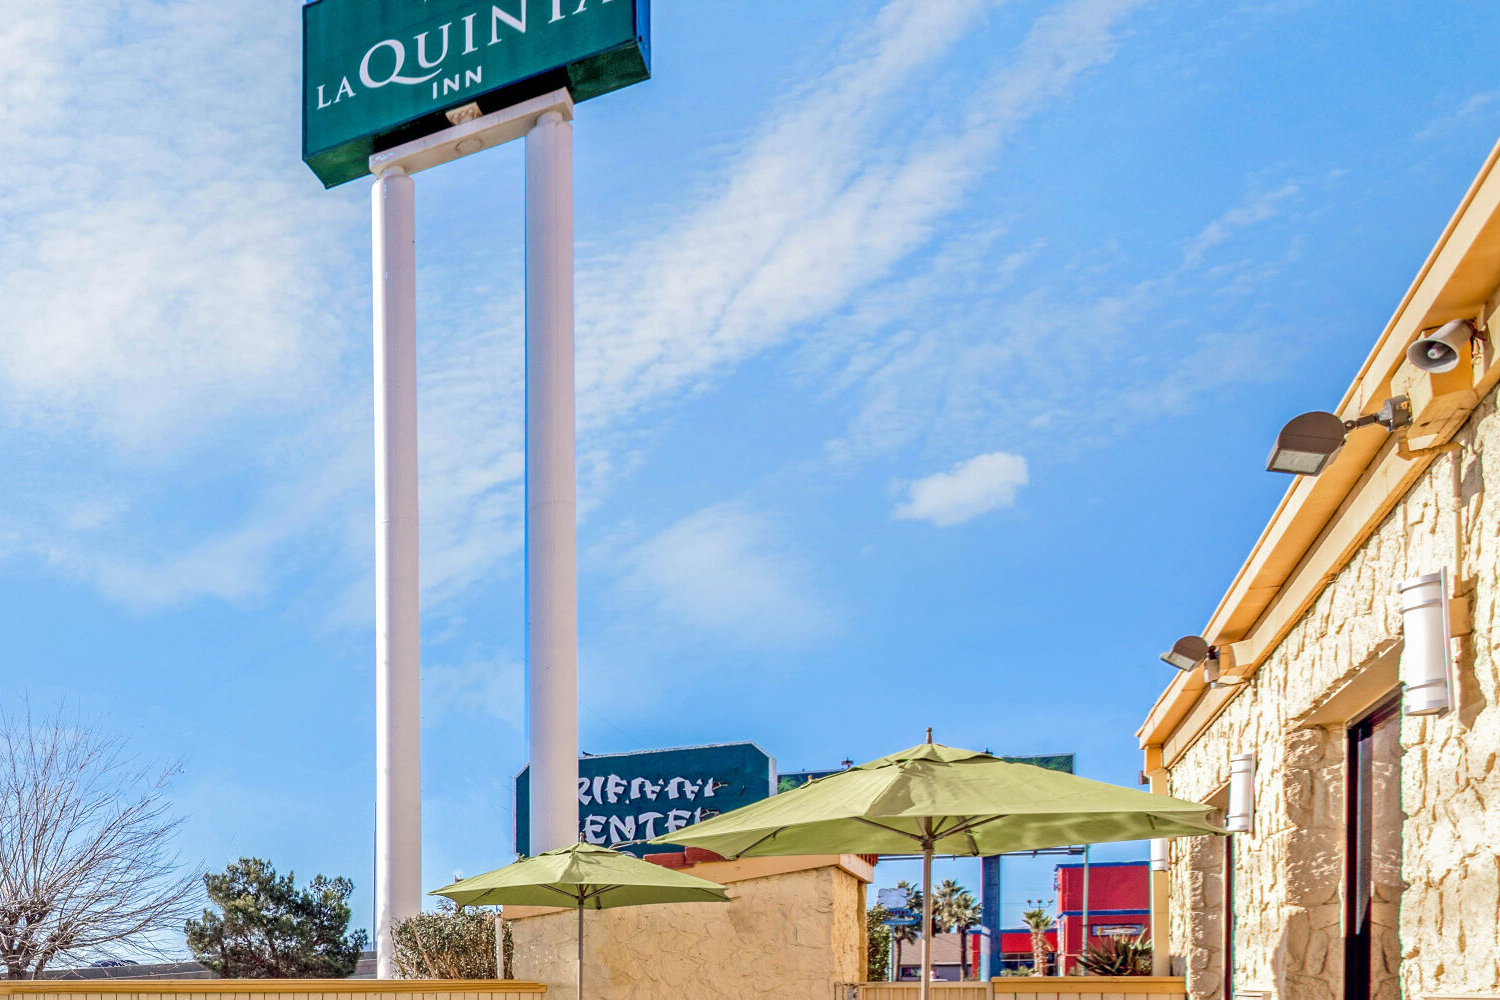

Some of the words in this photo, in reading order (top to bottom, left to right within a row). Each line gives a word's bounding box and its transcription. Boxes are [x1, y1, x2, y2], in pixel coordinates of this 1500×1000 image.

[316, 76, 357, 110] LA
[358, 0, 612, 89] QUIN
[432, 65, 483, 99] INN
